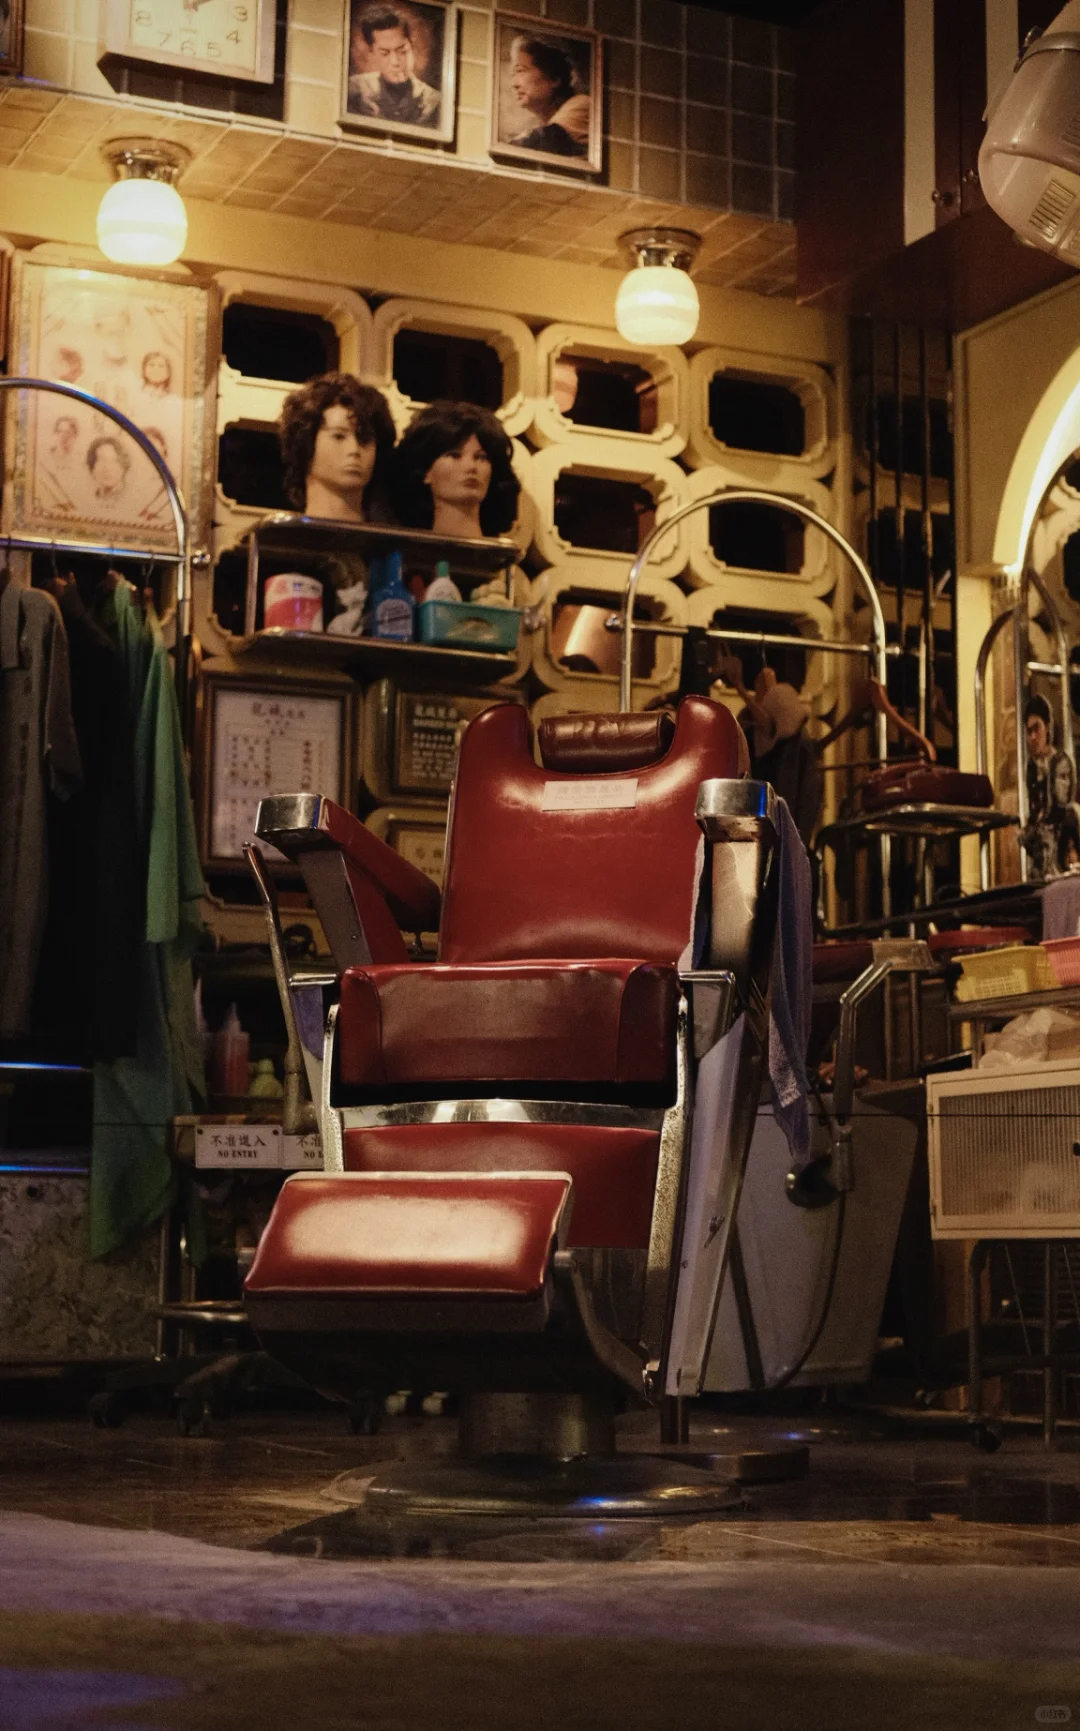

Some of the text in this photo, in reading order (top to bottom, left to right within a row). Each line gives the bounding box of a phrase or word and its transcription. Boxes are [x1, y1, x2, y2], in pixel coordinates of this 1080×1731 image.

[135, 9, 152, 27] 8
[233, 4, 249, 22] 3
[157, 30, 172, 47] 7
[225, 29, 241, 45] 4
[180, 39, 197, 58] 6
[207, 41, 222, 58] 5
[210, 1134, 267, 1147] 不准進入
[218, 1150, 258, 1158] NO ENTRY
[303, 1151, 316, 1159] NO
